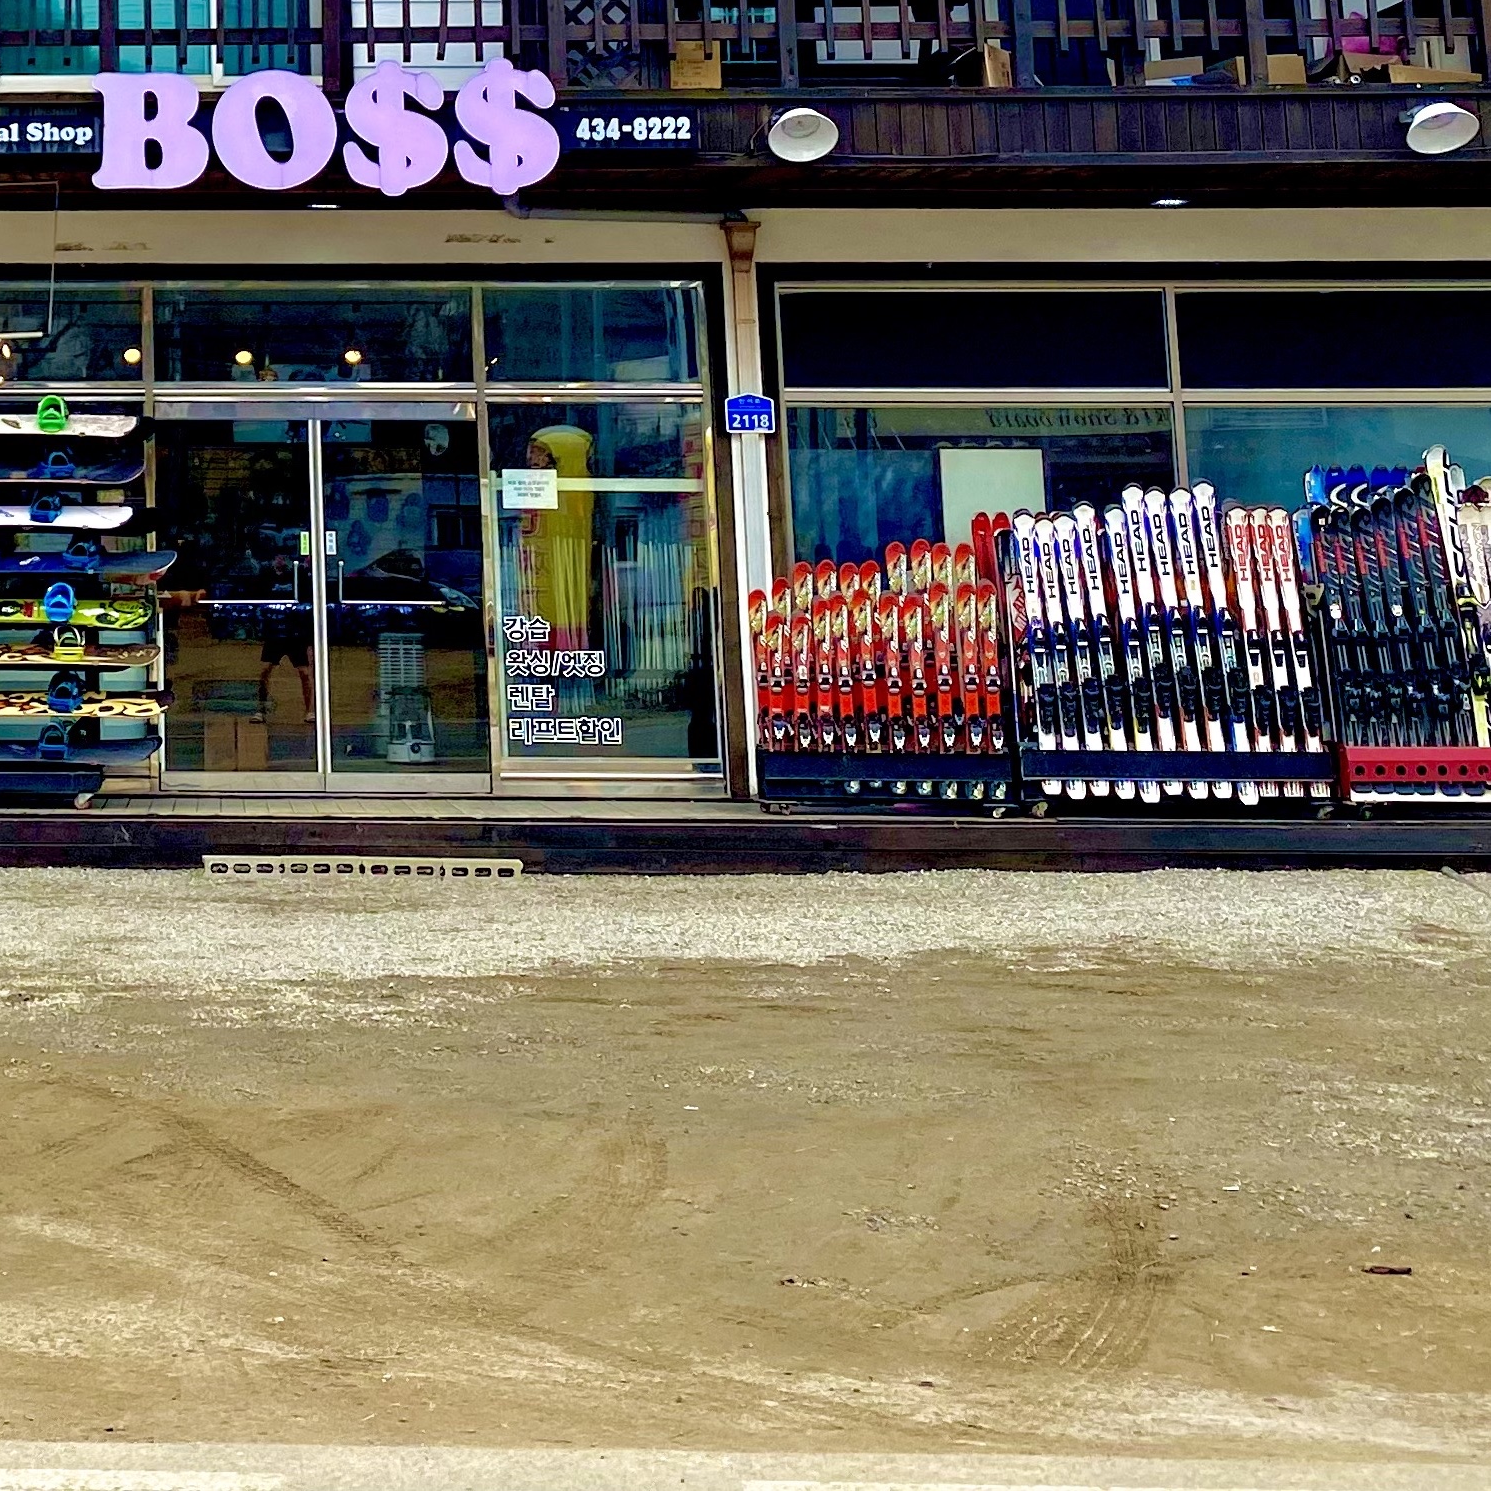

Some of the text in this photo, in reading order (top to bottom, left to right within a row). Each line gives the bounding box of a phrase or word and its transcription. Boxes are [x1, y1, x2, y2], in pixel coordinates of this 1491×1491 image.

[26, 122, 93, 145] Shop
[576, 116, 691, 141] 434-8222
[732, 413, 769, 428] 2118
[1083, 527, 1099, 590] HEAD
[1114, 532, 1129, 594] HEAD
[1131, 510, 1147, 571] HEAD
[1153, 514, 1170, 575] HEAD
[1179, 513, 1195, 574] HEAD
[1201, 506, 1218, 567] HEAD
[1235, 524, 1248, 581] HEAD
[1257, 524, 1272, 581] HEAD
[1276, 525, 1291, 582] HEAD
[1022, 537, 1034, 593] HEAD
[1043, 542, 1056, 598] HEAD
[1063, 539, 1077, 594] HEAD
[503, 615, 551, 642] 강습
[506, 650, 605, 677] 왓싱/엣징
[507, 684, 555, 711] 렌탈
[509, 716, 623, 746] 리프트할인
